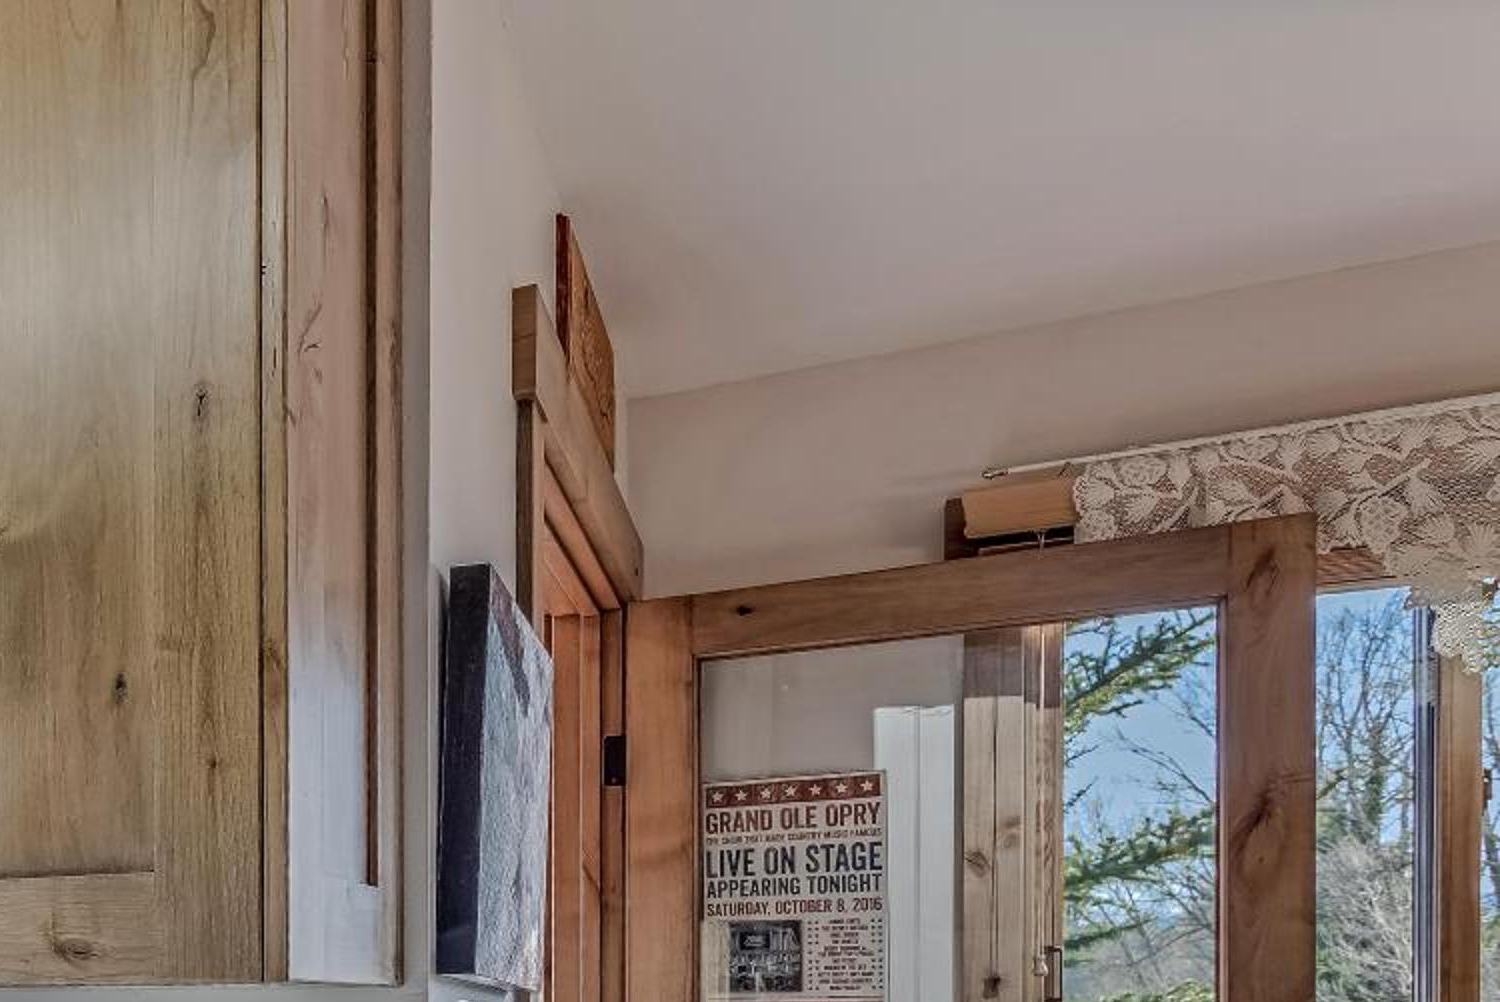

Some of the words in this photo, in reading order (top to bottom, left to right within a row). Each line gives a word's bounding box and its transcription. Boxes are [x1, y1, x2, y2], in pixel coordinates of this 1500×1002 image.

[706, 809, 773, 834] GRAND
[781, 806, 817, 830] OLE
[826, 802, 881, 827] OPRY
[706, 848, 756, 878] LIVE
[764, 845, 796, 875] ON
[805, 841, 883, 873] STAGE
[707, 877, 801, 899] APPEARING
[808, 873, 883, 895] TONIGHT
[707, 901, 771, 917] SATURDAY,
[775, 898, 833, 915] OCTOBER
[853, 896, 883, 912] 2016
